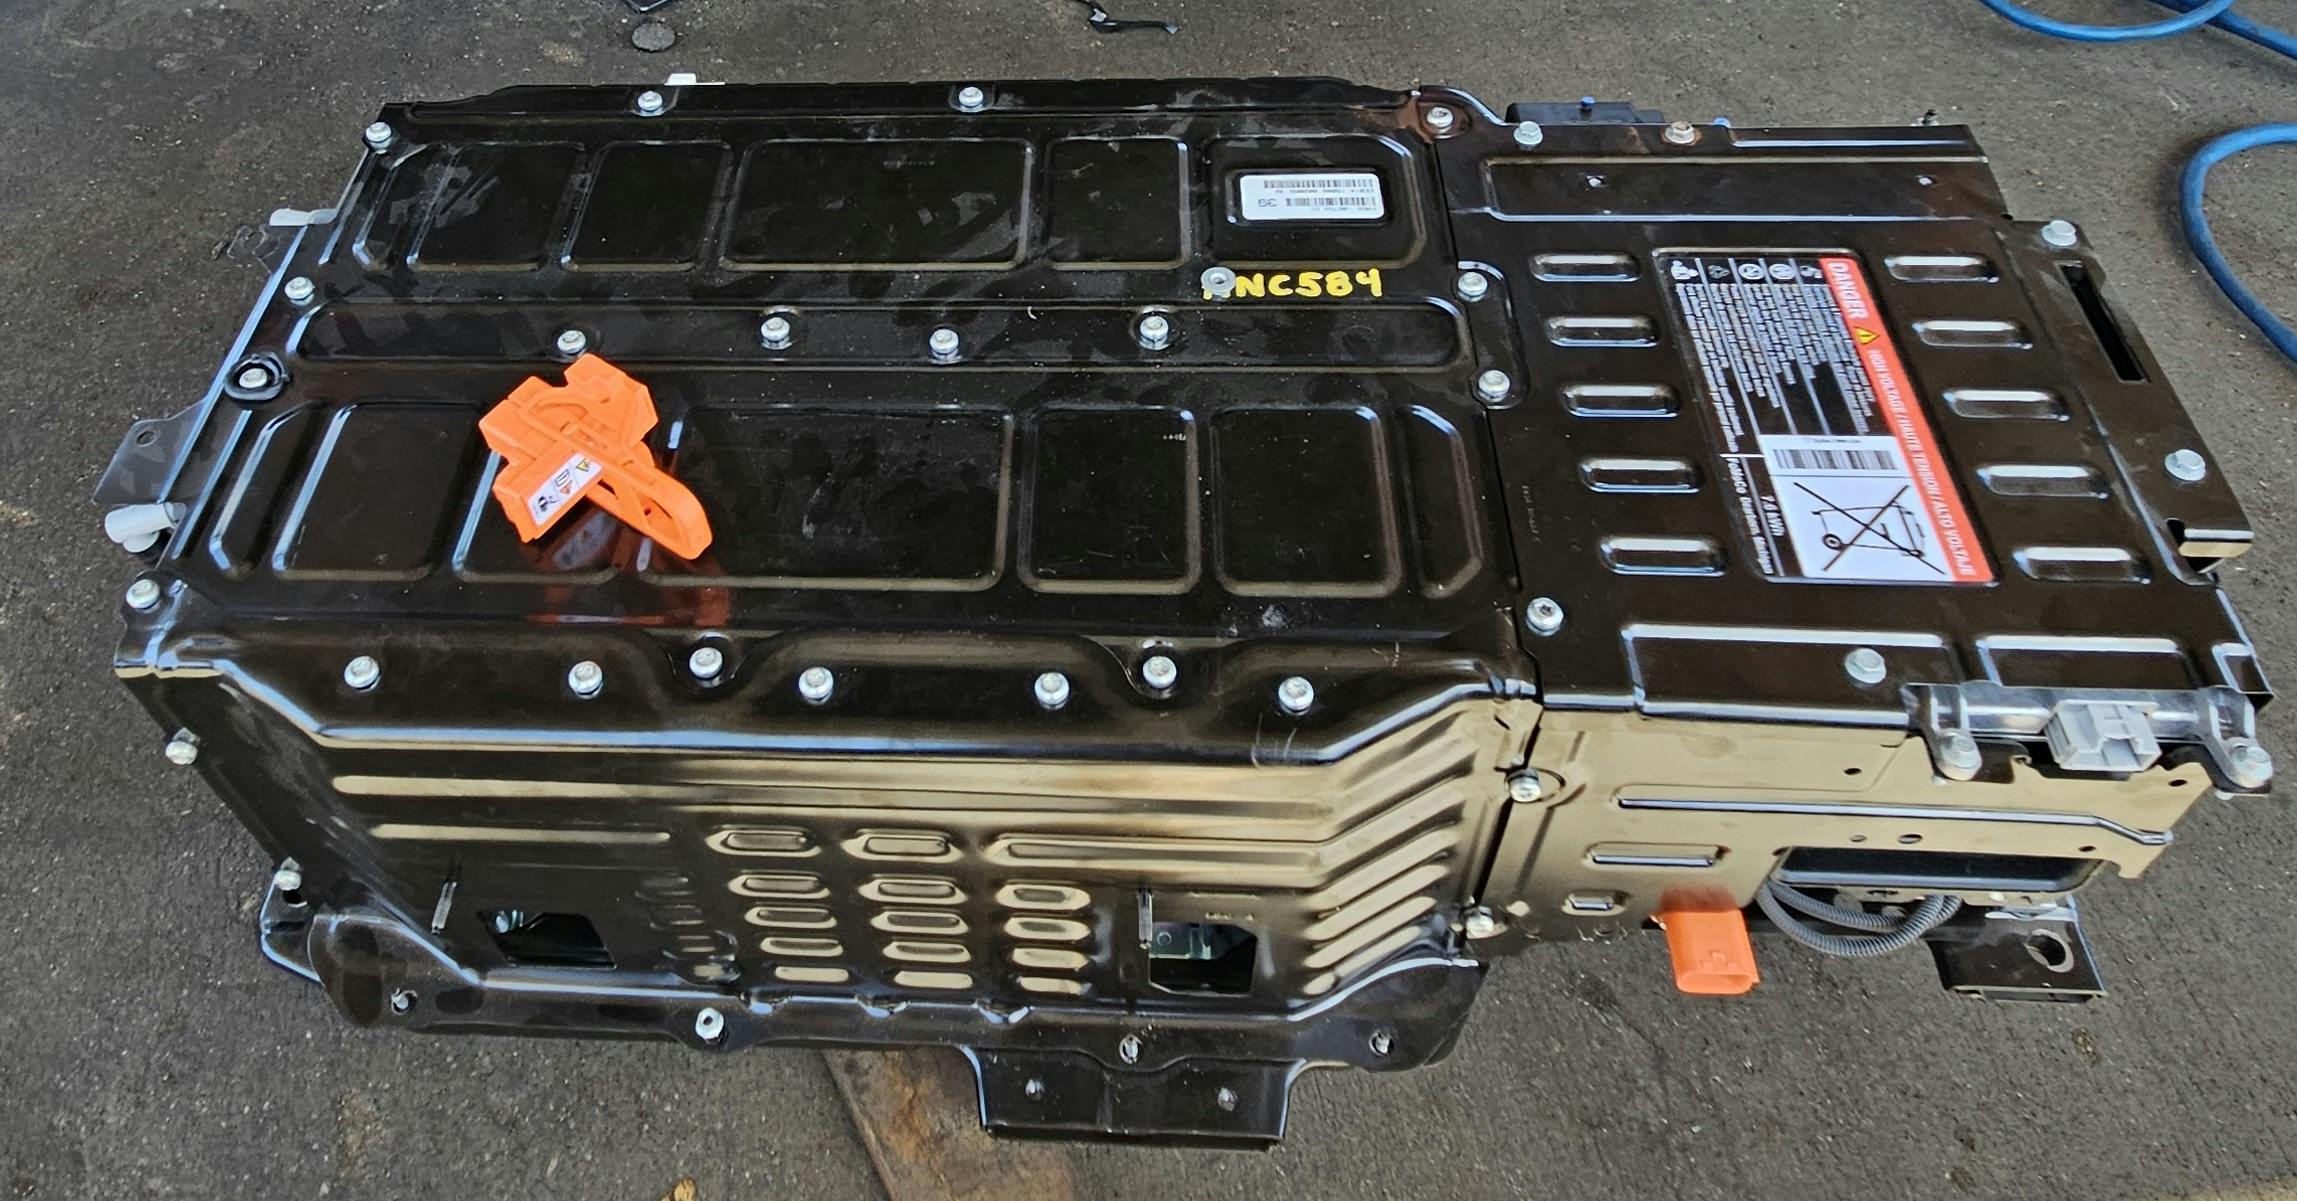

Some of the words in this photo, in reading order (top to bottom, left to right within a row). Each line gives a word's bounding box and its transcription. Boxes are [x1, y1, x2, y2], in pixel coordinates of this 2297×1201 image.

[1828, 262, 1868, 318] DANGER
[1865, 350, 1888, 371] HIGH
[1874, 373, 1906, 411] VOLTAGE
[1895, 420, 1924, 450] HAUTE
[1909, 454, 1942, 494] TENSION
[1763, 512, 1788, 536] kWh
[1930, 500, 1957, 527] ALTO
[1941, 529, 1978, 575] VOLTAJE
